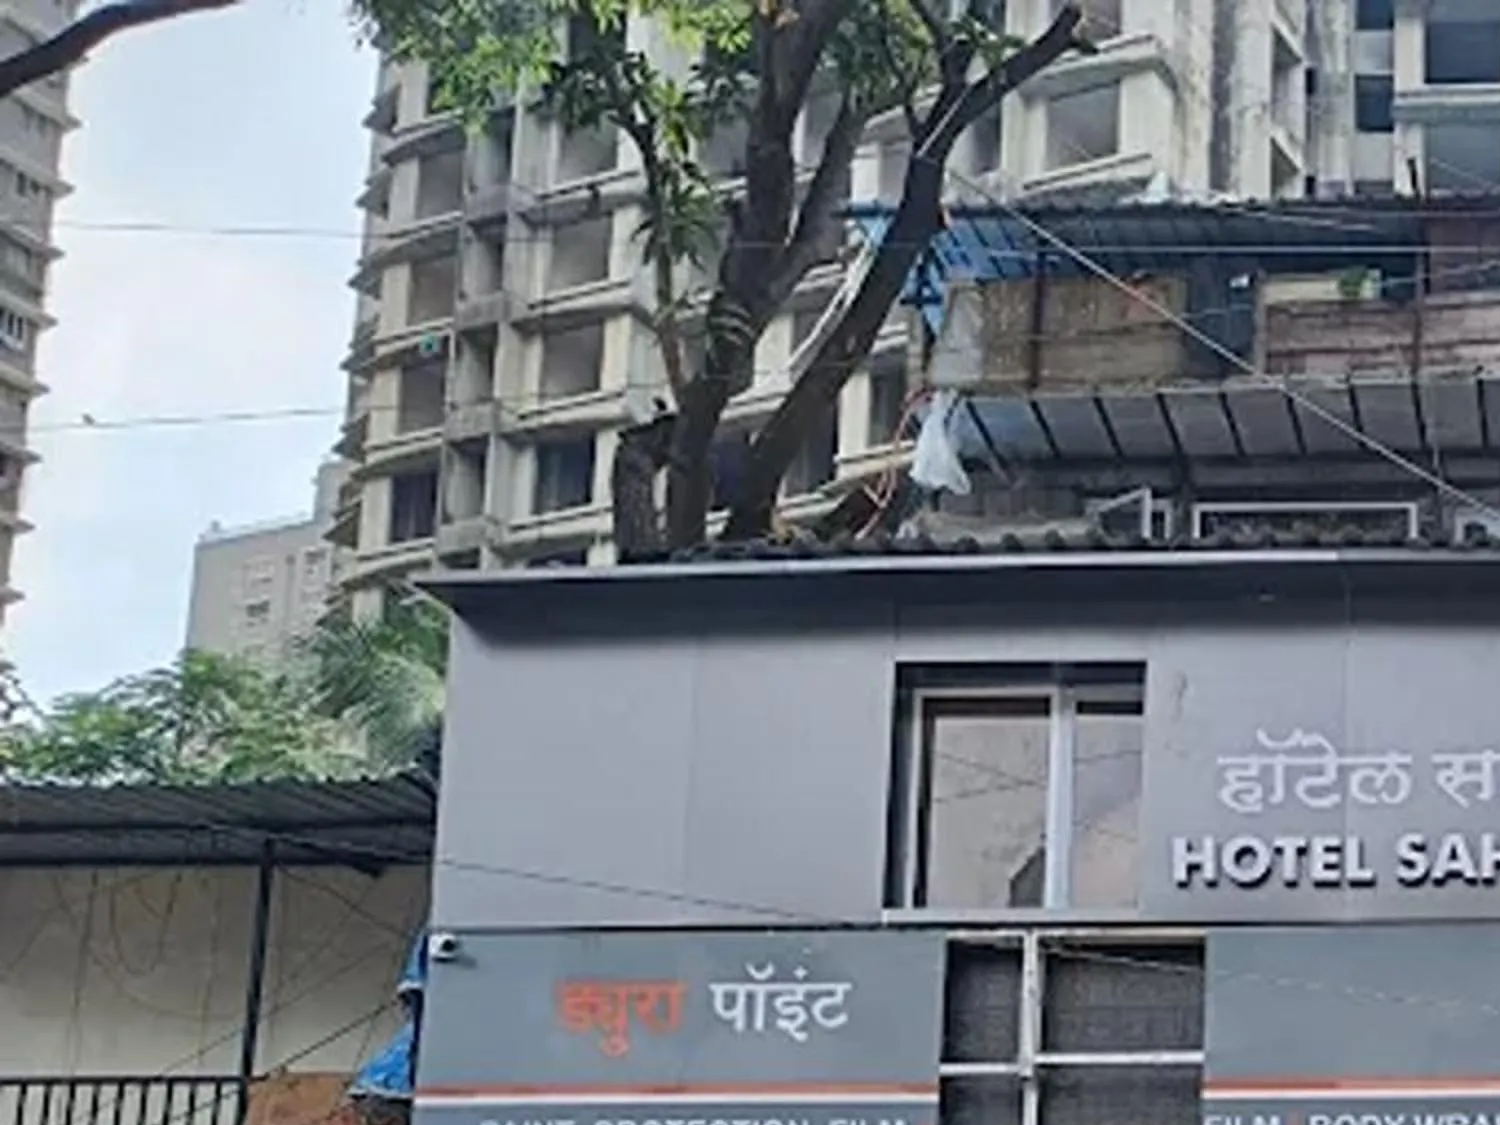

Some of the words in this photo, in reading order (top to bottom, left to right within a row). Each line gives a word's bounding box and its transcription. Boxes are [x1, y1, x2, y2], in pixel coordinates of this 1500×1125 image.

[1216, 727, 1413, 814] हॉटेल
[1171, 834, 1378, 889] HOTEL
[707, 960, 852, 1043] पॉइंट
